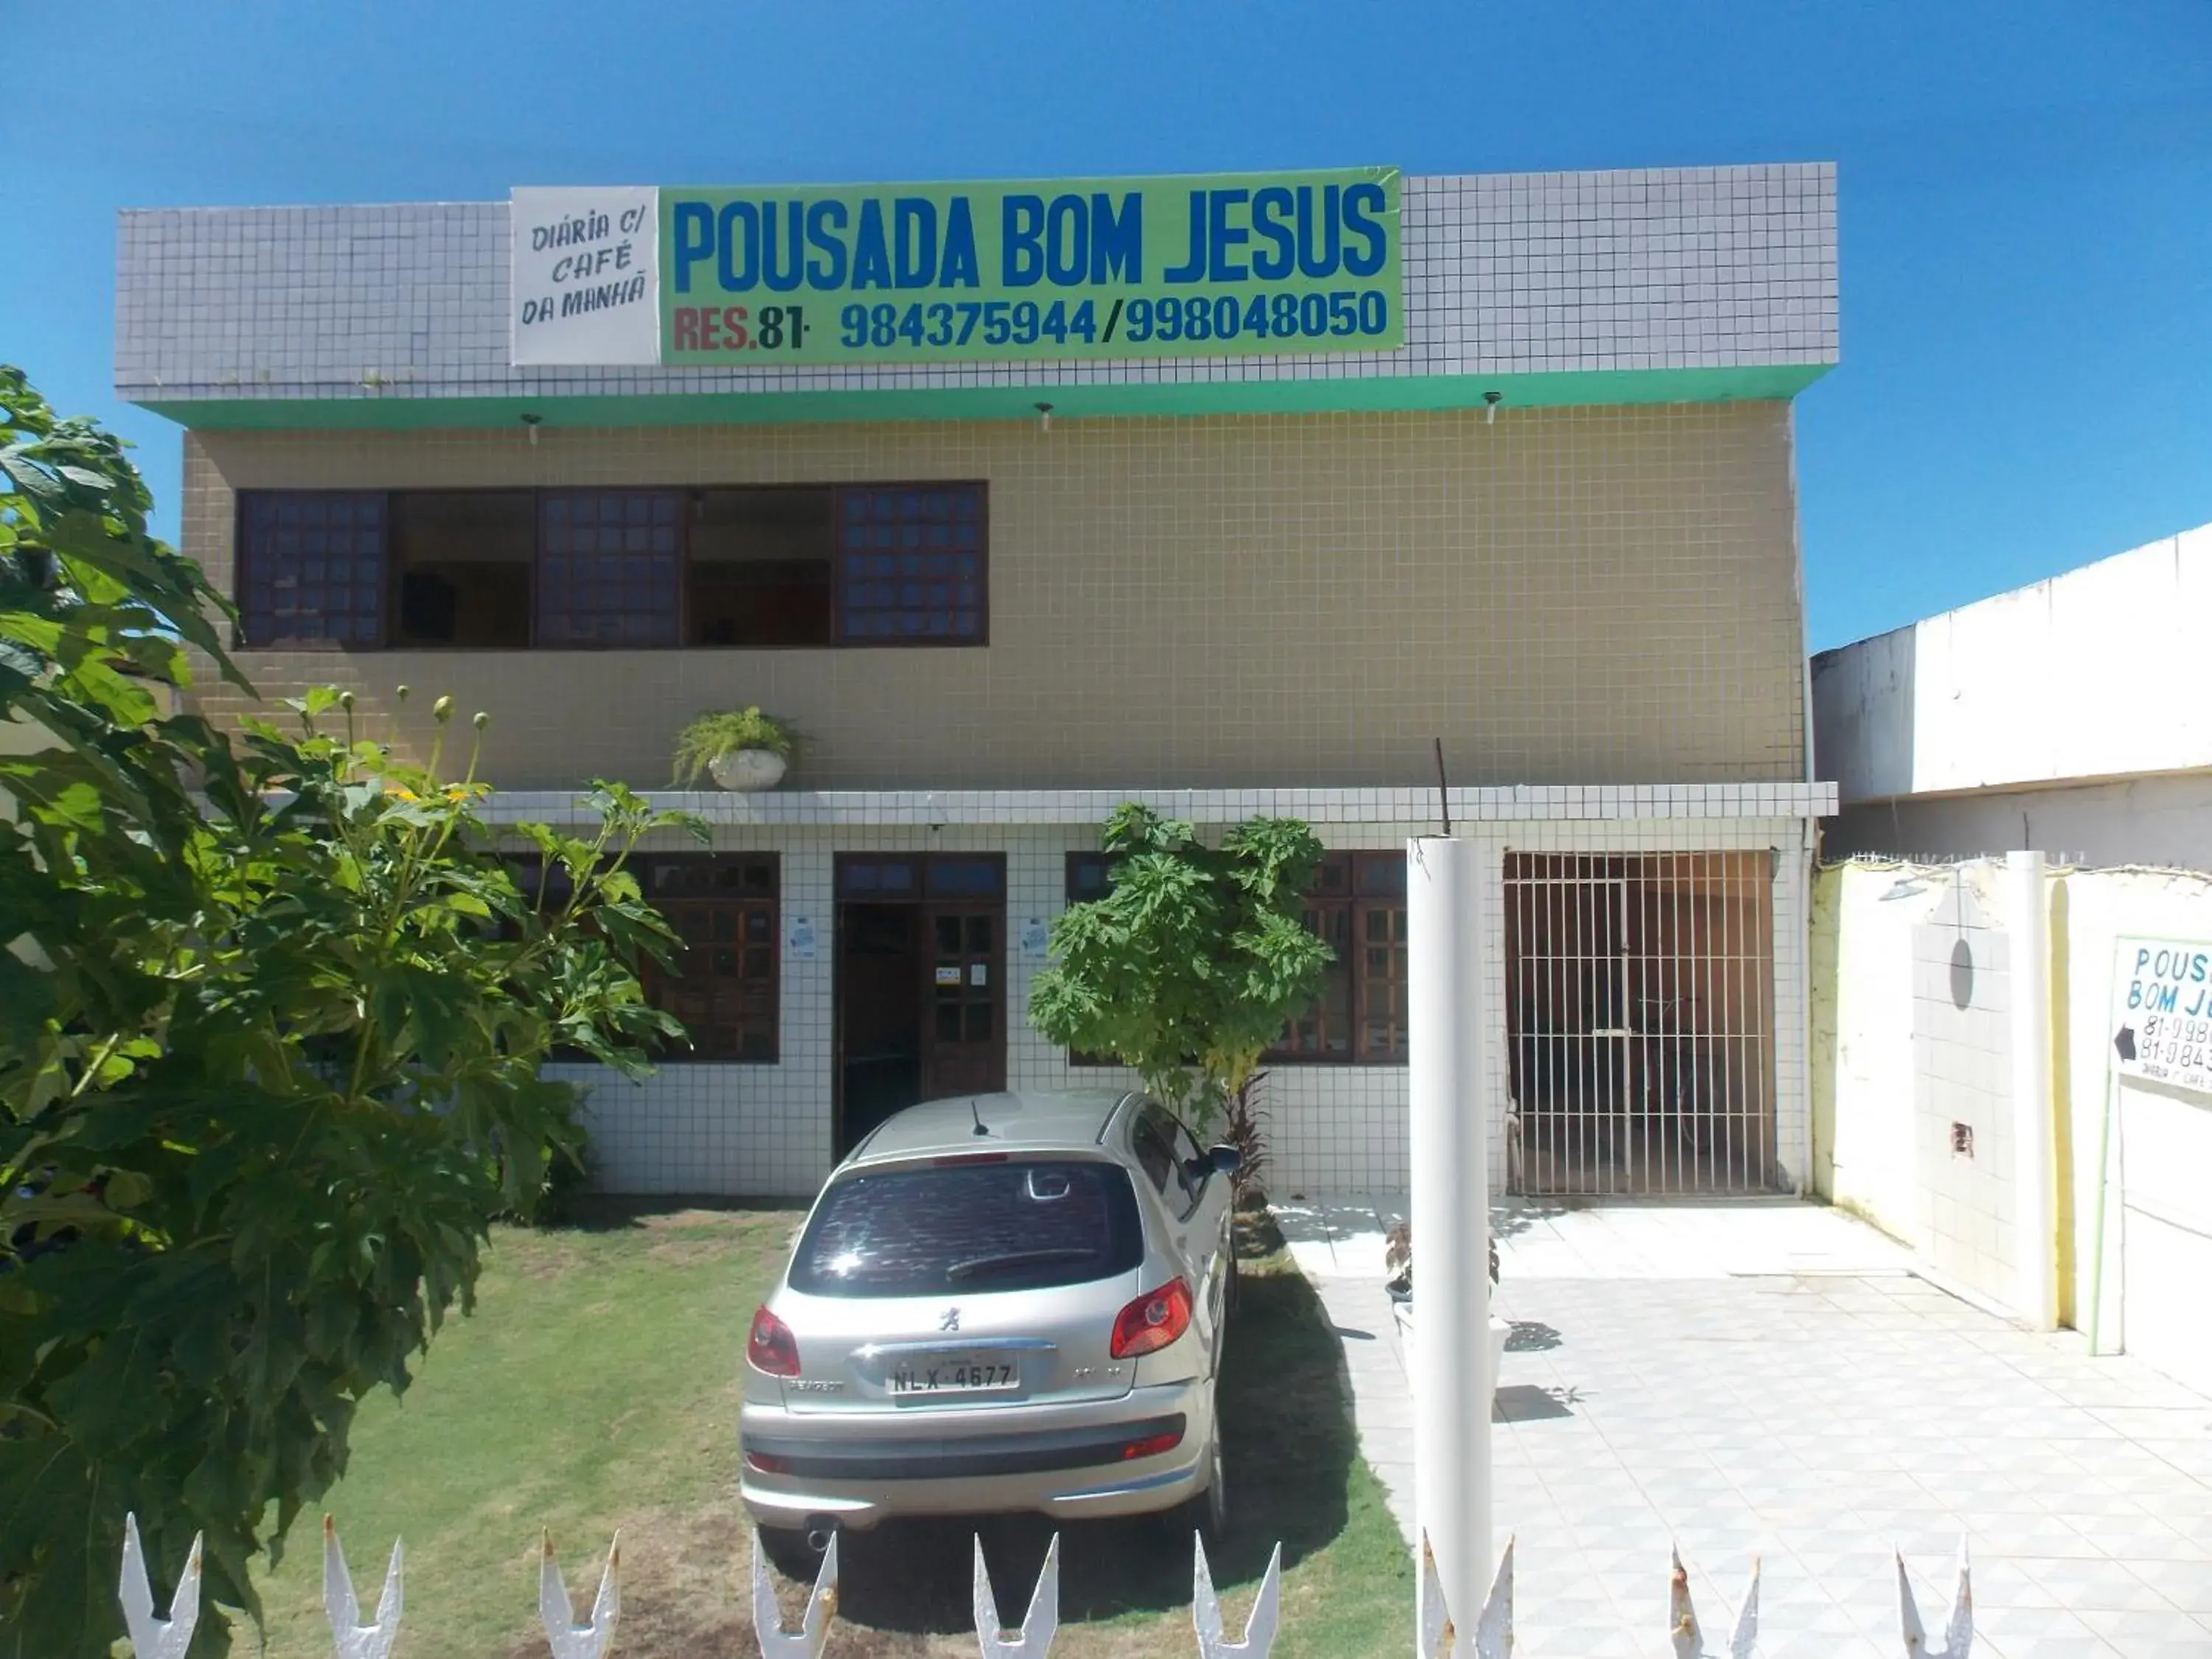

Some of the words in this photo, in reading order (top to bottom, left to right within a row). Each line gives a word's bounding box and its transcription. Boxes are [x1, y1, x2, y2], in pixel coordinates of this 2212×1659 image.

[619, 204, 646, 234] C/
[674, 196, 980, 293] POUSADA
[1002, 192, 1142, 288] BOM
[1164, 183, 1387, 284] JESUS
[552, 238, 633, 283] CAFÉ
[521, 296, 554, 325] DA
[560, 269, 647, 319] MANHÃ
[2135, 947, 2212, 984] POUS
[2127, 980, 2179, 1014] BOM
